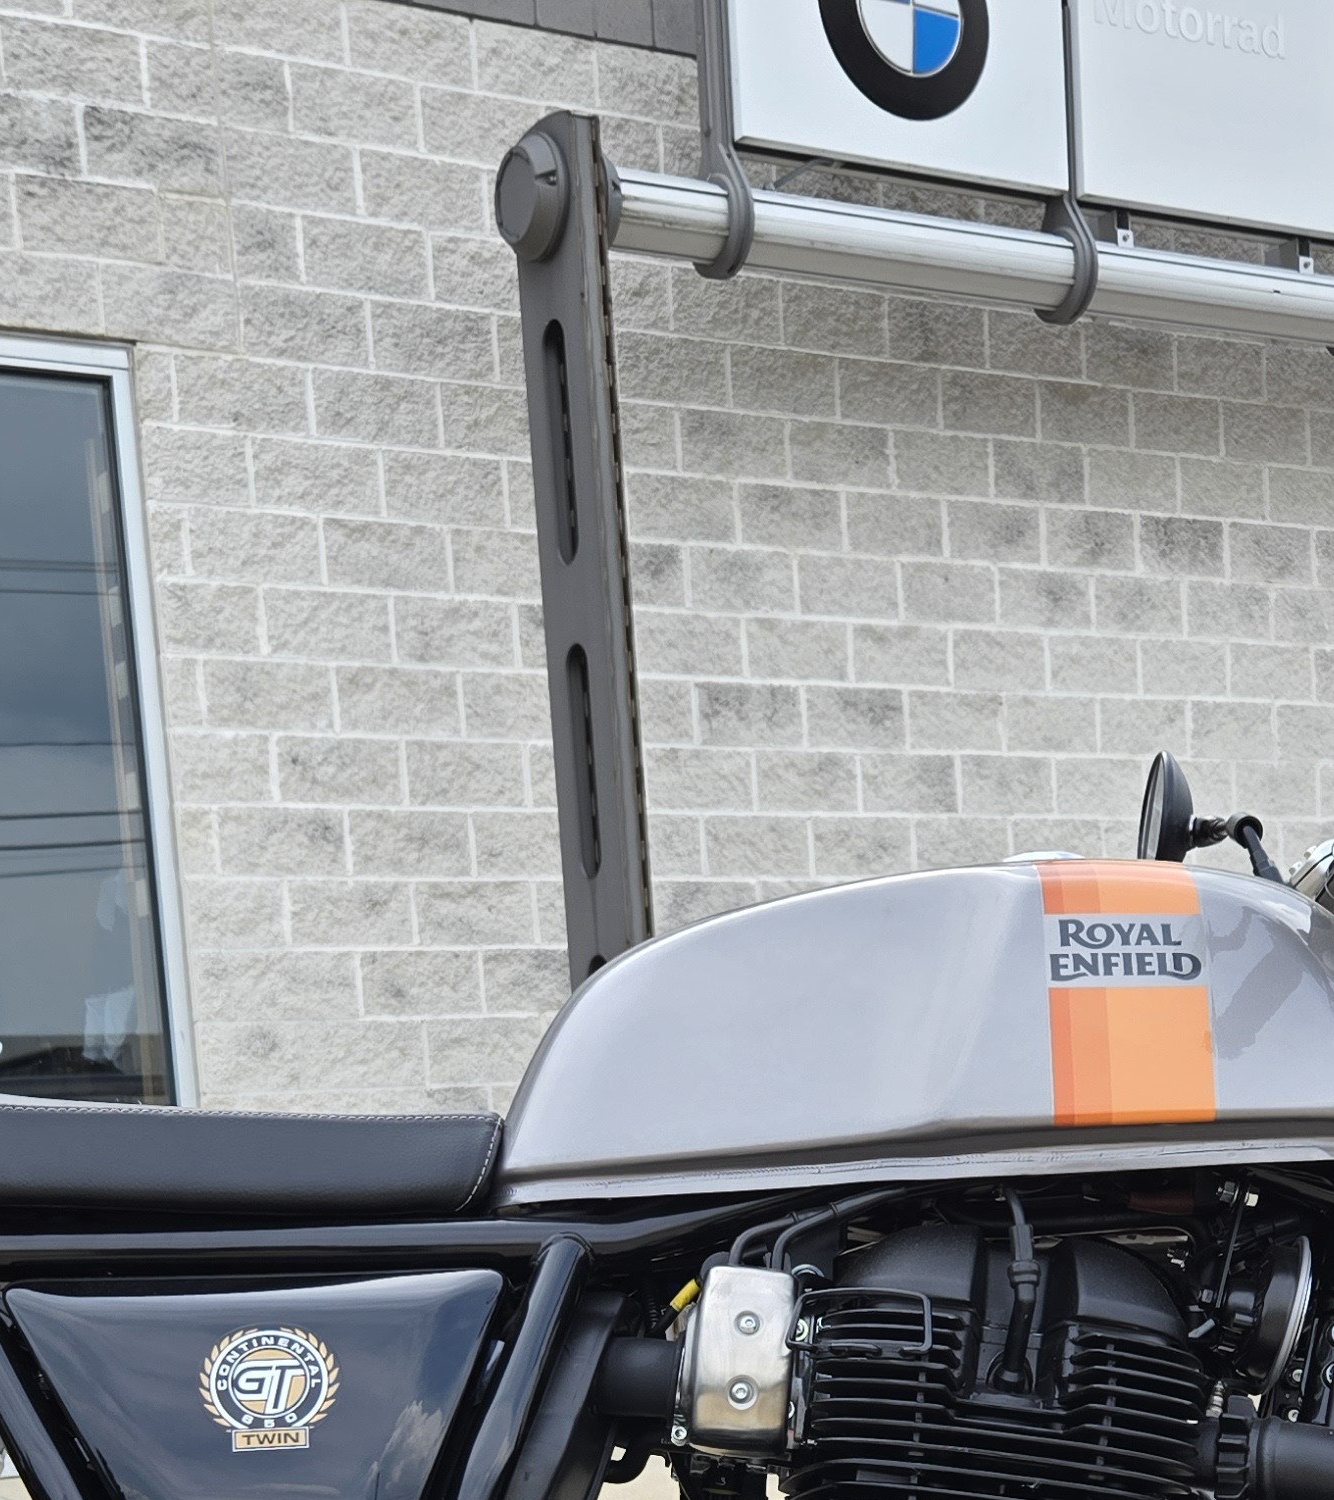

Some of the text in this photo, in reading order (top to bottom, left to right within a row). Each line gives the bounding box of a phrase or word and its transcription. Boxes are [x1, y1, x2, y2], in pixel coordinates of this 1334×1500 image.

[1093, 0, 1286, 60] Motorrad
[1058, 919, 1182, 949] ROYAL
[1050, 952, 1202, 981] ENFIELD
[217, 1336, 321, 1391] CONTINENTAL
[233, 1358, 306, 1414] GT
[241, 1412, 298, 1428] 650
[242, 1432, 300, 1446] TWIN
